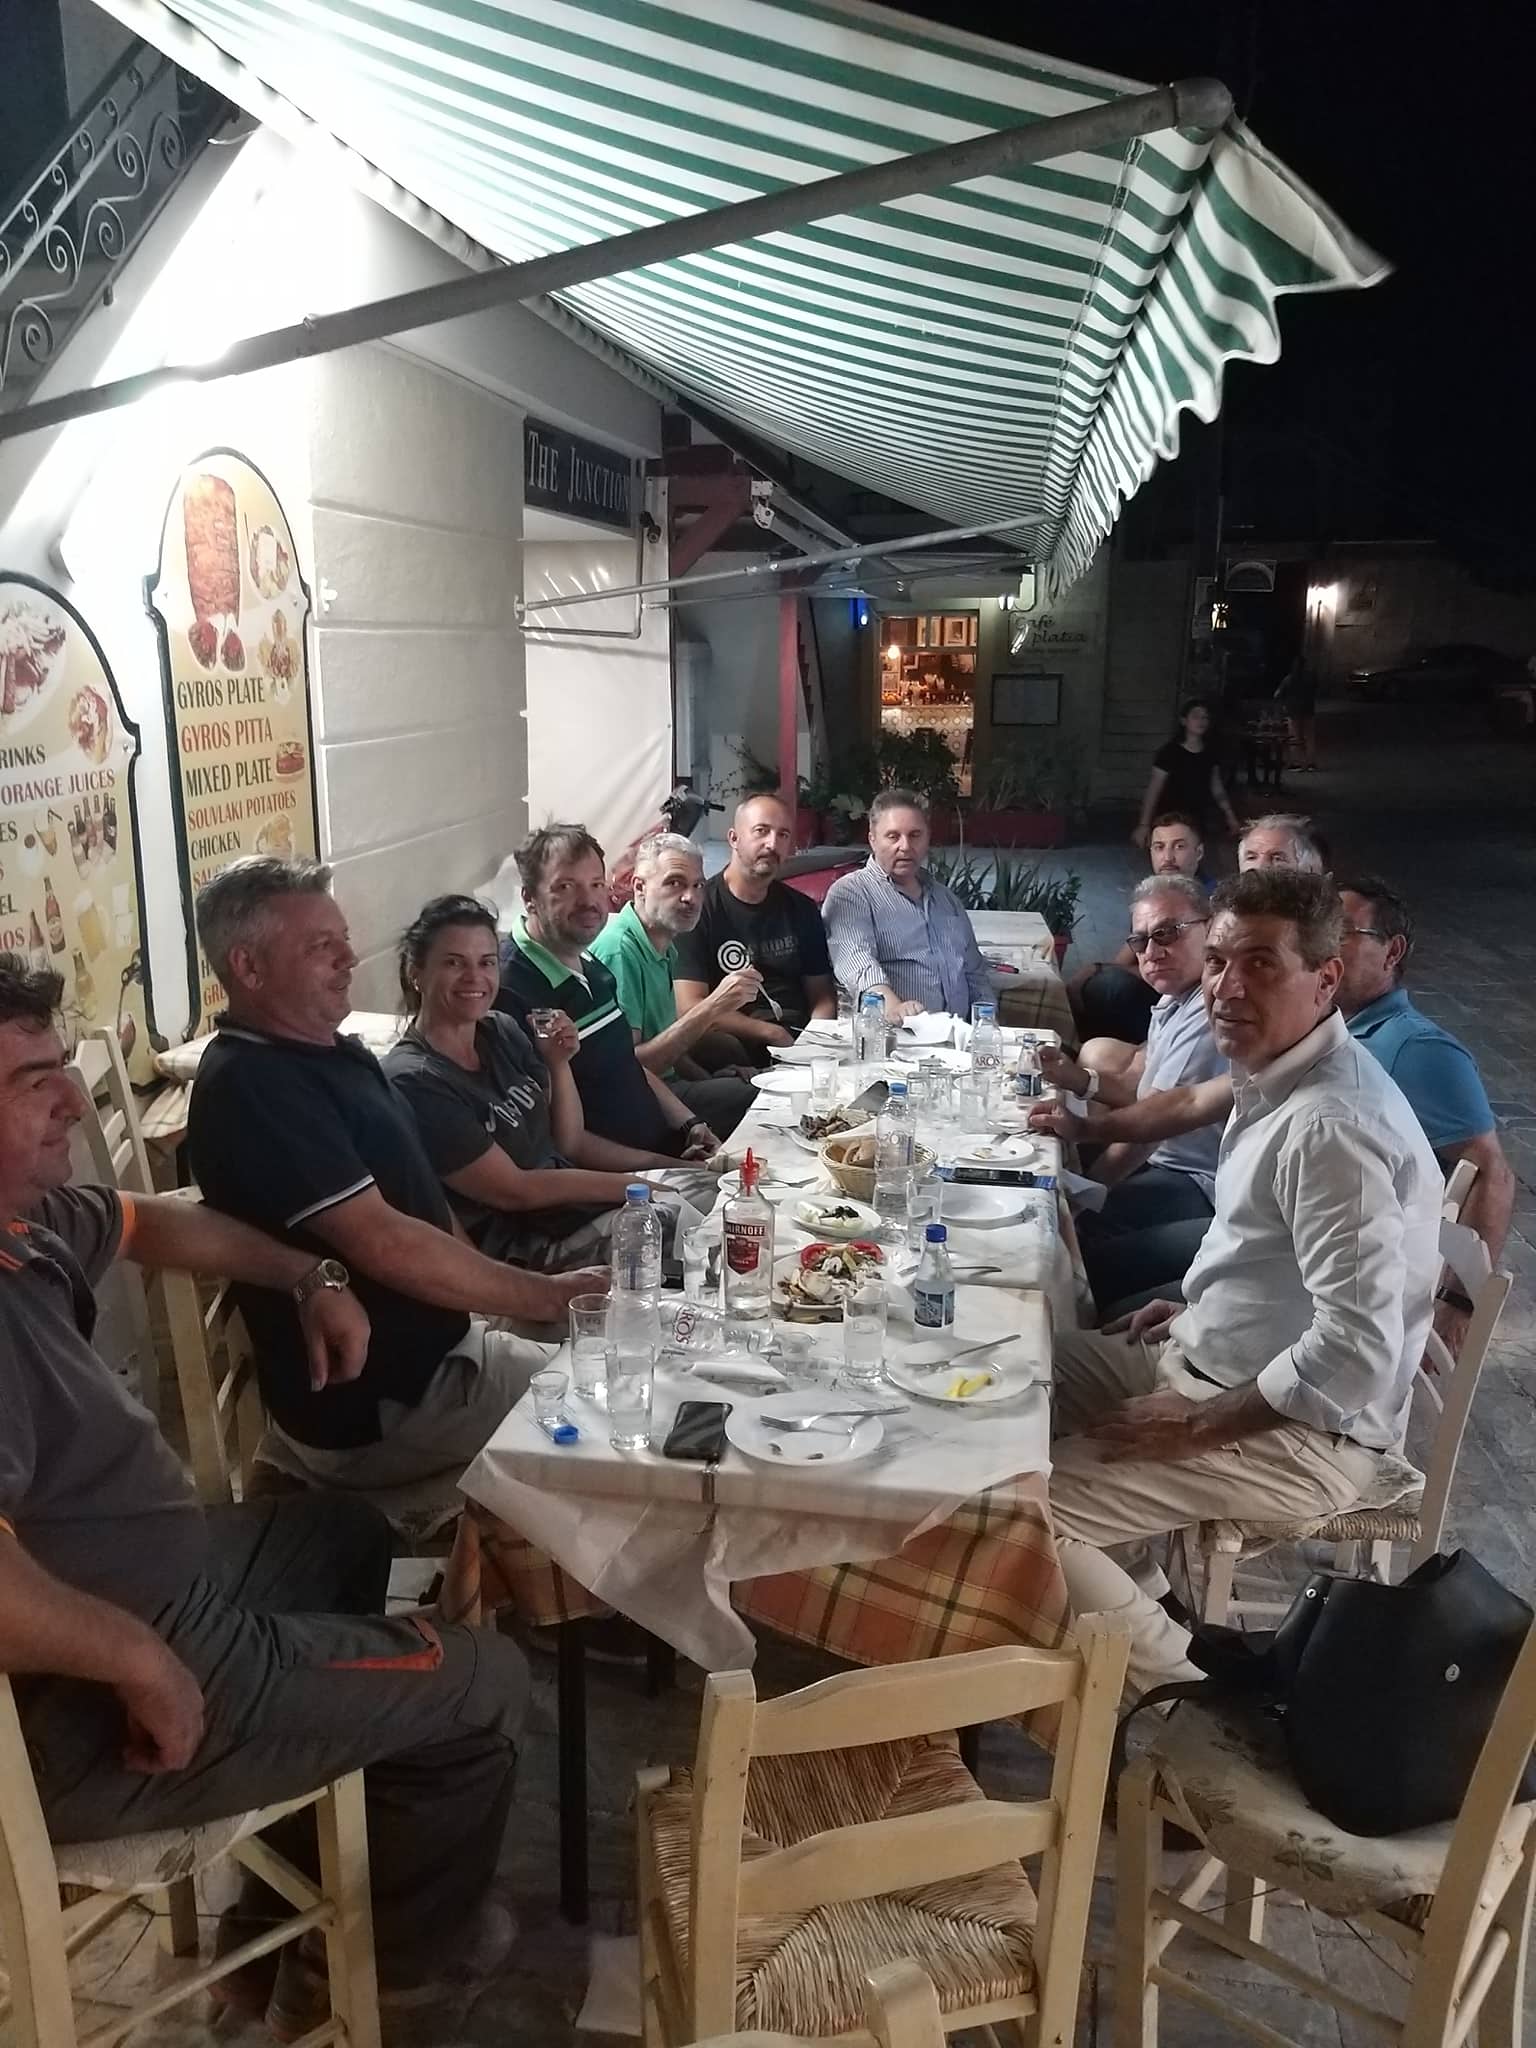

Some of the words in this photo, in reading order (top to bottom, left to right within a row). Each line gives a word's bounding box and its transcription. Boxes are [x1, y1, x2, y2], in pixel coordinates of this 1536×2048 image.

[177, 678, 224, 710] GYROS
[227, 676, 265, 706] PLATE
[181, 721, 232, 754] GYROS
[235, 716, 273, 747] PITTA
[0, 743, 46, 769] RINKS
[1, 776, 64, 806] ORANGE
[68, 768, 116, 794] JUICES
[185, 764, 232, 799] MIXED
[235, 757, 273, 789] PLATE
[188, 802, 243, 832] SOUVLAKI
[246, 790, 297, 819] POTATOES
[190, 831, 242, 861] CHICKEN
